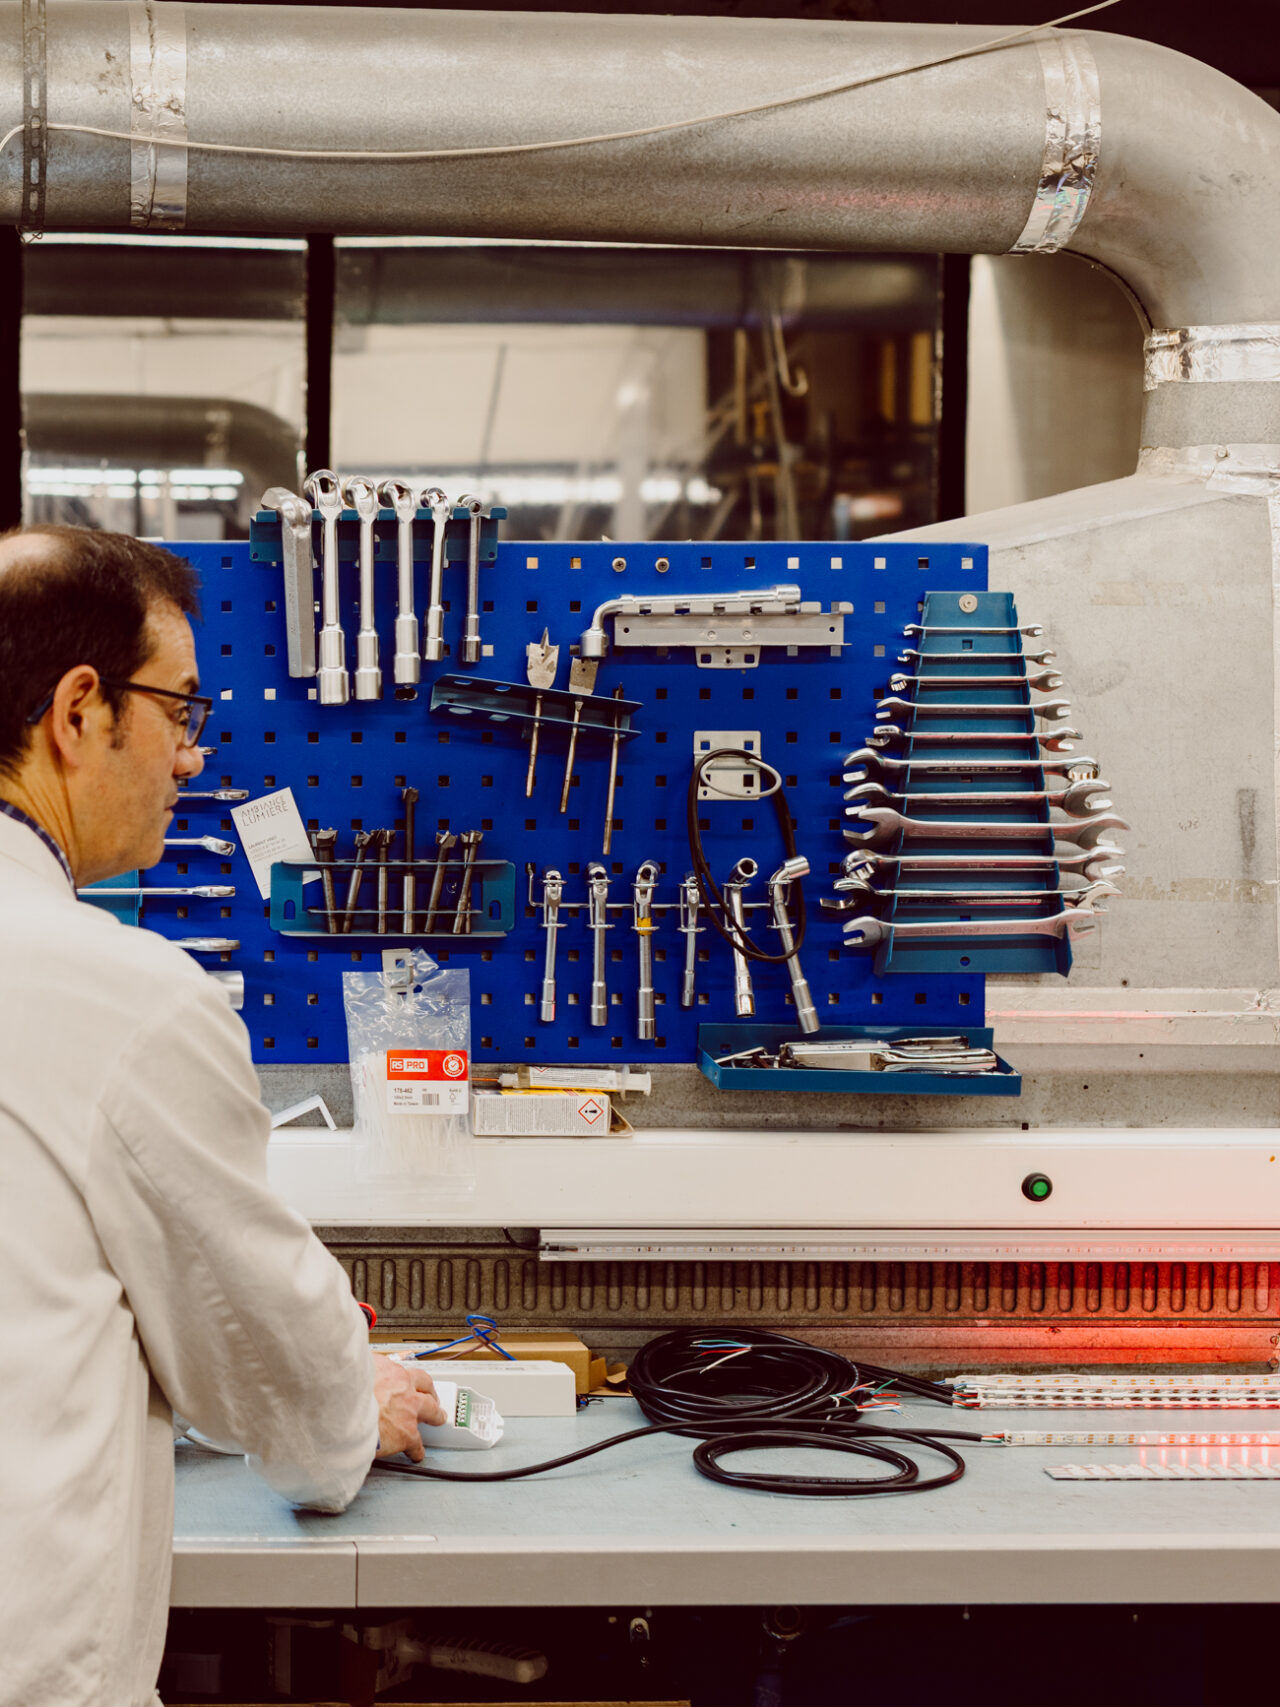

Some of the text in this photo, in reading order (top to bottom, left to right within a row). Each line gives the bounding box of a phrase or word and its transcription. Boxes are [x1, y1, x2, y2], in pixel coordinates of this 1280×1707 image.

[241, 795, 285, 817] AMBIANCE
[391, 1061, 425, 1070] RS PRO
